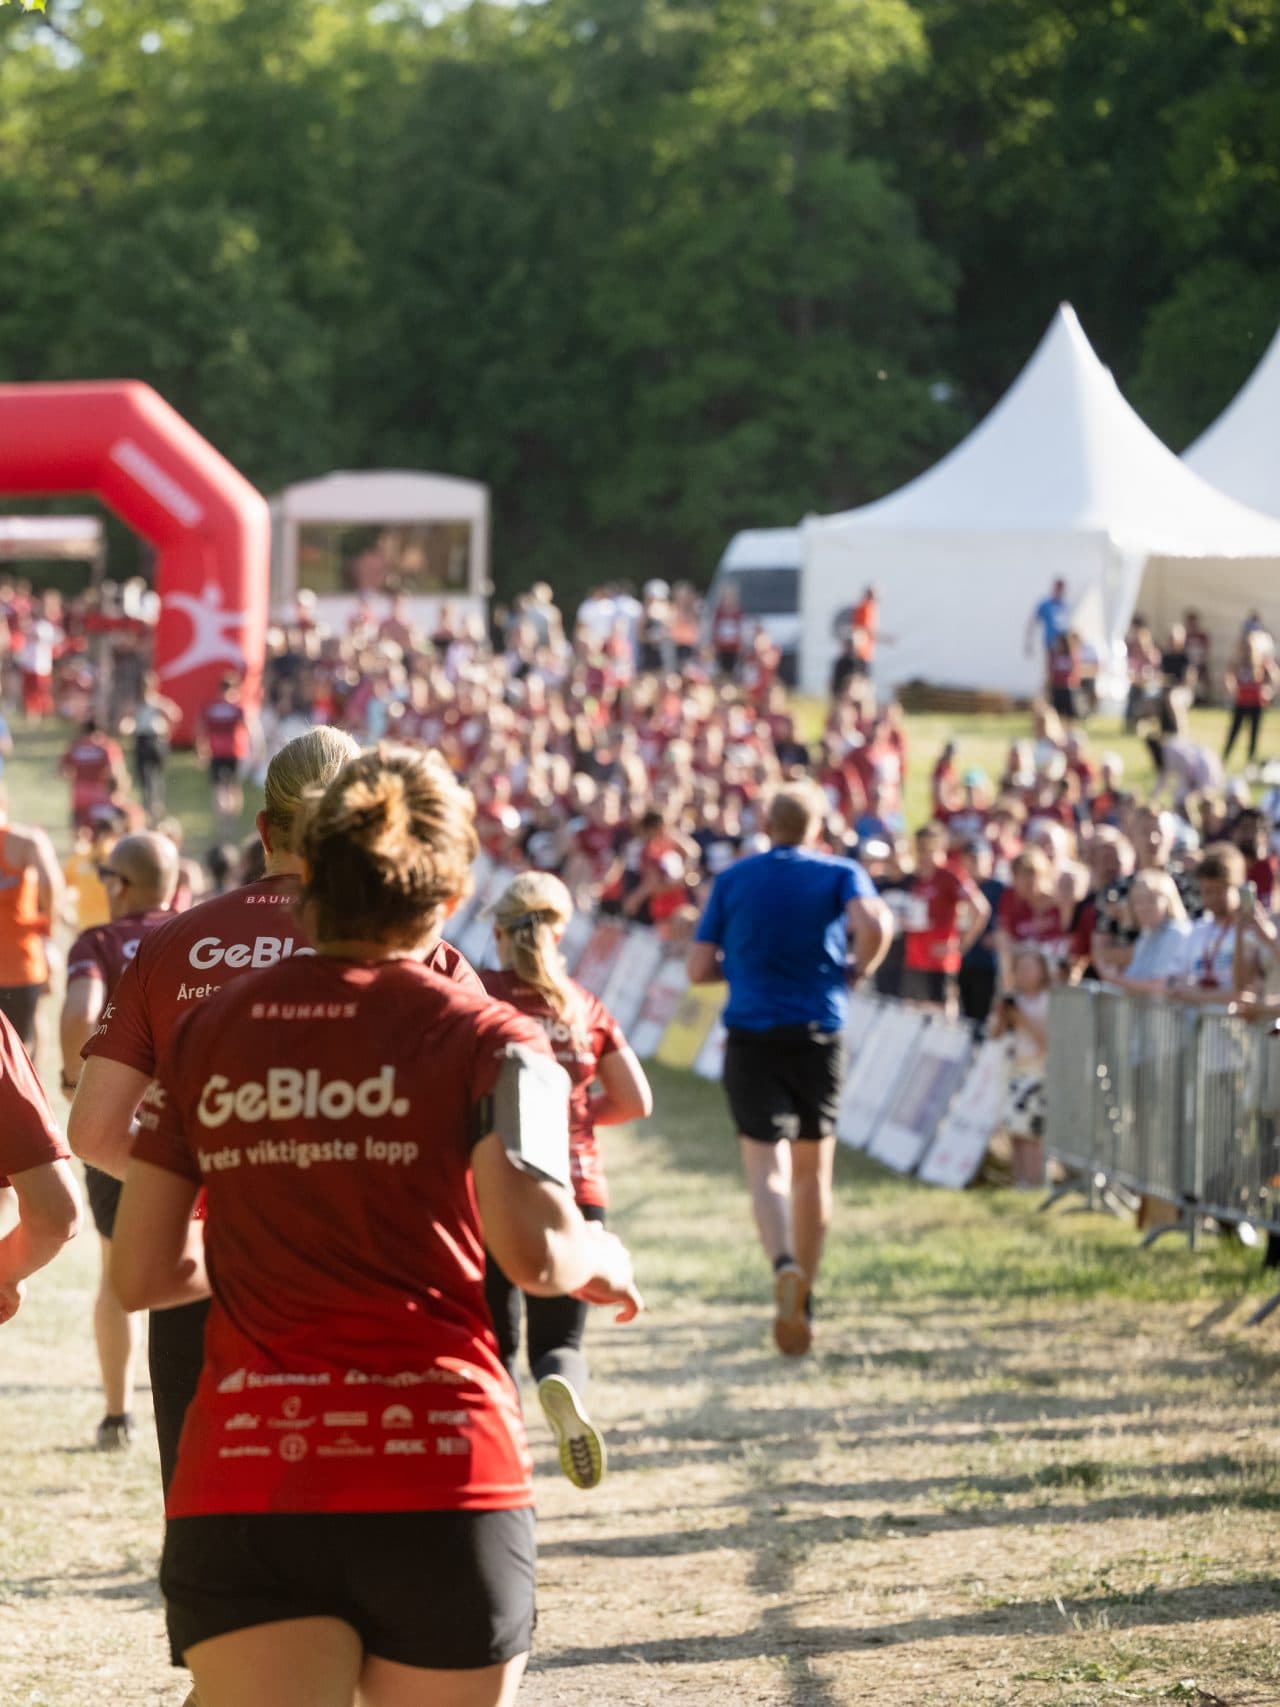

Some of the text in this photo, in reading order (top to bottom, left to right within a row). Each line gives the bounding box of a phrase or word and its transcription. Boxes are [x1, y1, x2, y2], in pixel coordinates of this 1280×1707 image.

[251, 1003, 358, 1019] BAUHAUS
[197, 1065, 410, 1128] GeBlod.
[246, 1137, 358, 1170] viktigaste
[364, 1135, 420, 1167] lopp
